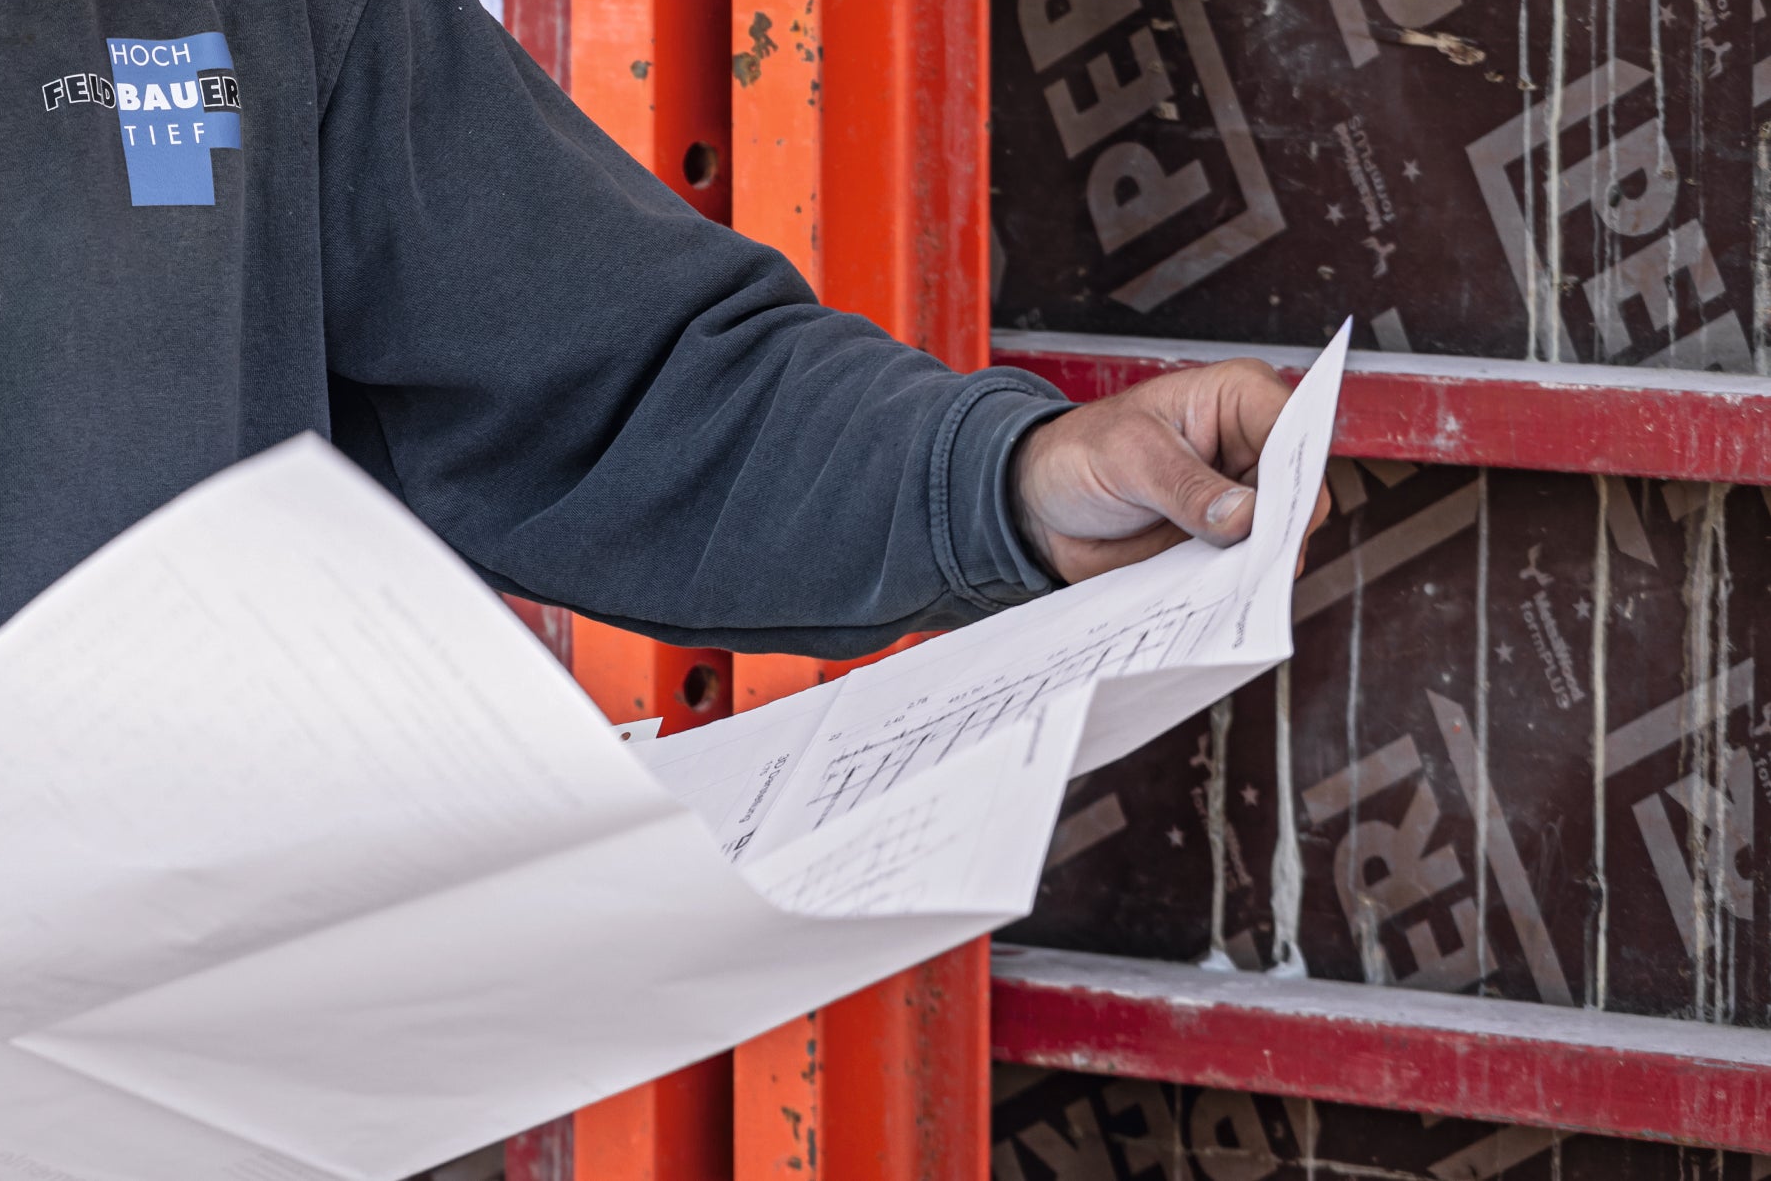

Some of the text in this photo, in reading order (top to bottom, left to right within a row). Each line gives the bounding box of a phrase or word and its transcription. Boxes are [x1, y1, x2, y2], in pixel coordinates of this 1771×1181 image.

[110, 42, 192, 67] HOCH
[42, 73, 242, 112] FELDBAUER
[123, 121, 206, 147] TIEF
